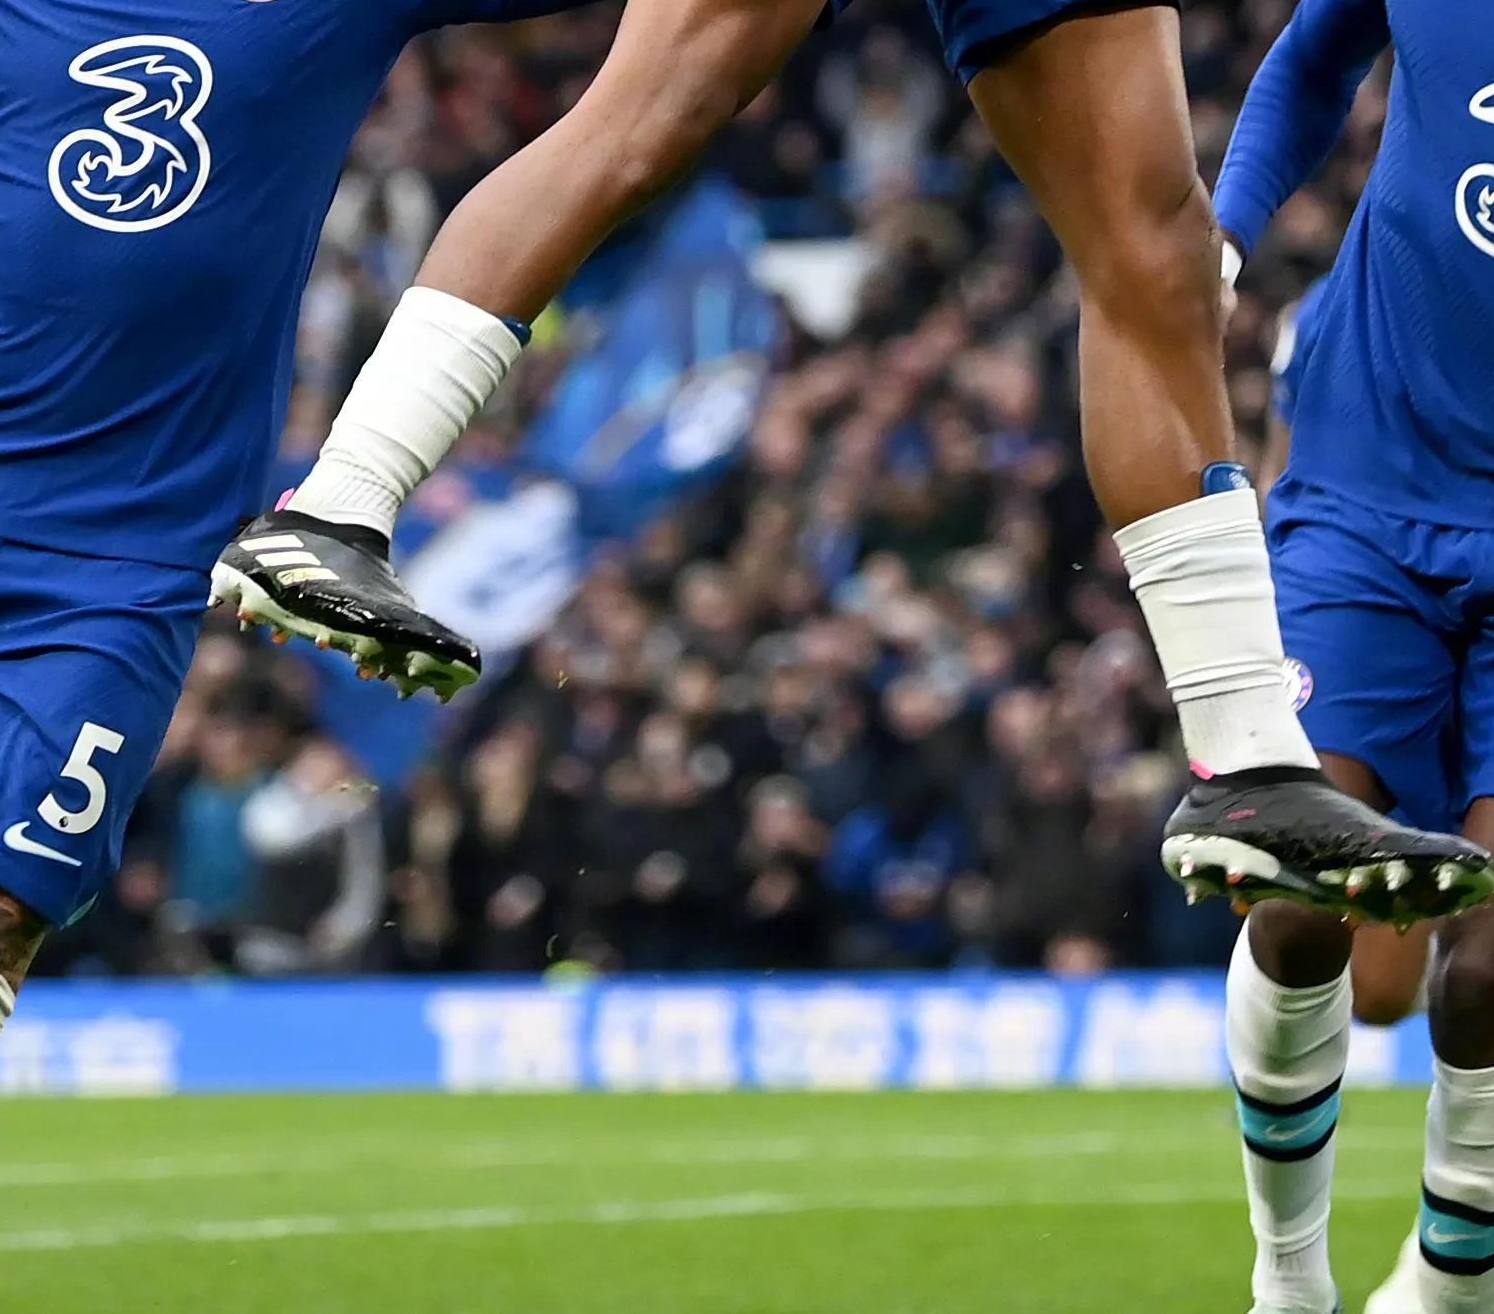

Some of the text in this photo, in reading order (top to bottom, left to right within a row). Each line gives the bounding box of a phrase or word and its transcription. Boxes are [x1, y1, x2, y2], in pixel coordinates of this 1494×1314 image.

[37, 721, 125, 834] 5
[429, 974, 1400, 1092] 顶级滚球体
